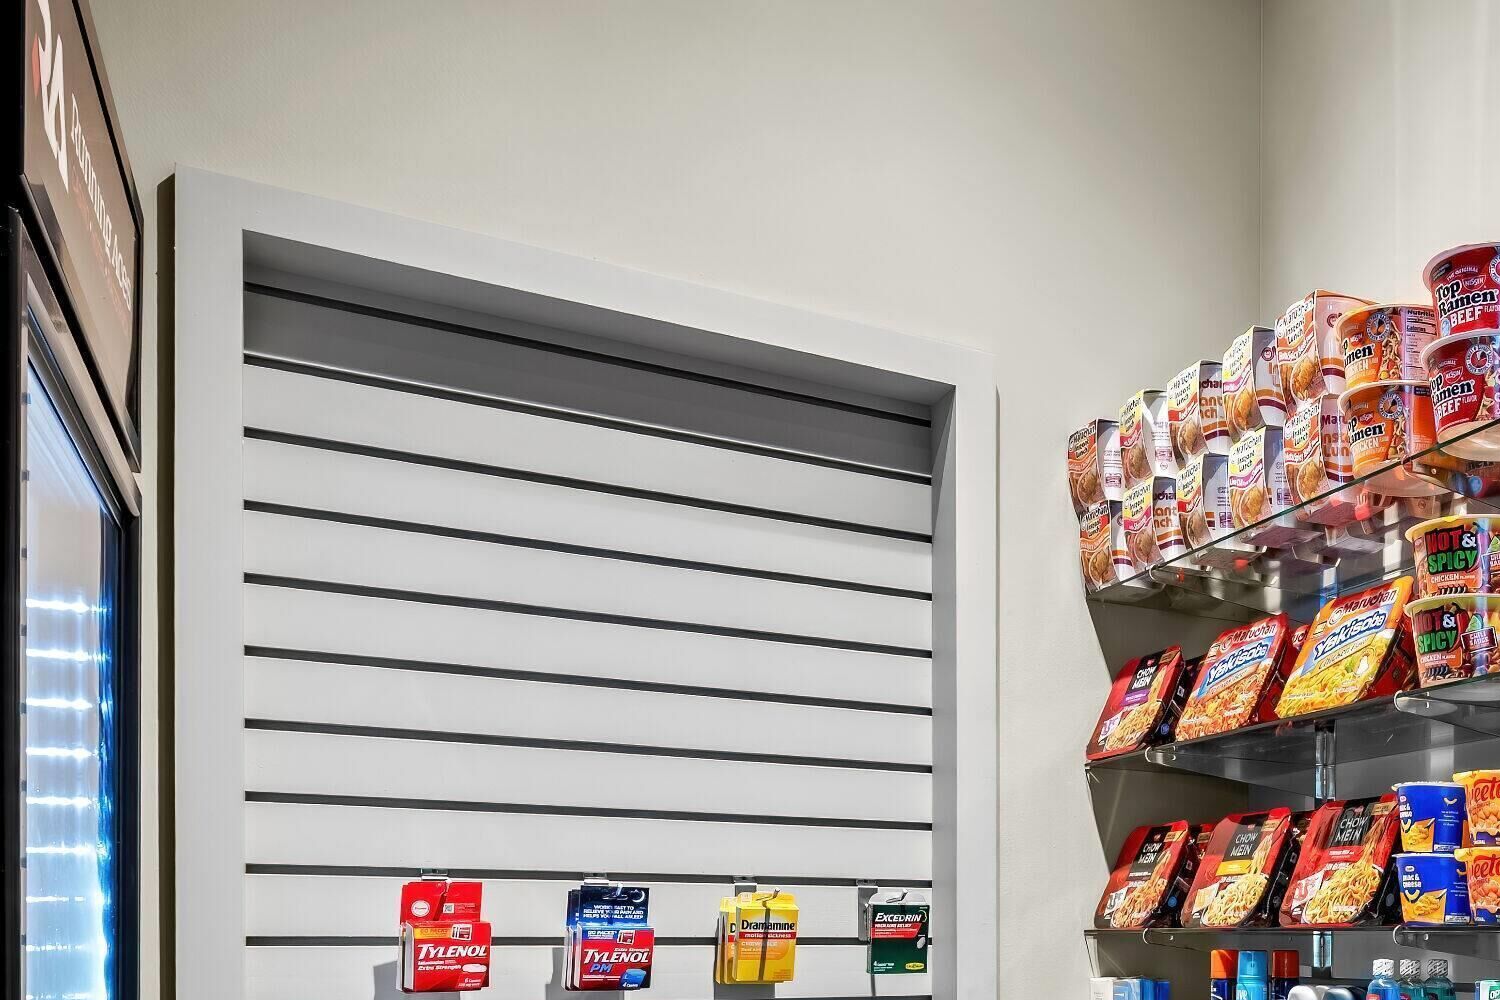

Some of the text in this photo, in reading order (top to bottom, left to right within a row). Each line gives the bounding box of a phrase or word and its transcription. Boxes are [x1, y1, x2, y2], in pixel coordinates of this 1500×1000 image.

[1436, 281, 1461, 302] Top
[1439, 291, 1497, 318] Ramen
[1451, 306, 1482, 327] BEEF
[1438, 401, 1461, 417] BEEF
[1426, 531, 1477, 553] HOT &
[1427, 551, 1477, 574] SPICY
[1431, 573, 1459, 584] CHICKEN
[1343, 589, 1398, 615] Maruchan
[1442, 613, 1456, 628] &
[1233, 623, 1276, 643] Maruchan
[1313, 611, 1387, 660] Yakisoba
[1418, 631, 1457, 654] SPICY
[1207, 642, 1269, 686] Yakisoba
[1340, 816, 1369, 830] CHOW
[1235, 831, 1258, 845] CHOW
[1334, 827, 1362, 843] MEIN
[1142, 842, 1162, 855] CHOW
[1230, 843, 1254, 858] MEIN
[1137, 852, 1158, 865] MEIN
[741, 919, 795, 931] Dramamine
[875, 912, 922, 923] EXCEDRIN
[417, 944, 488, 960] TYLENOL
[583, 949, 650, 964] TYLENOL
[590, 963, 613, 973] PM
